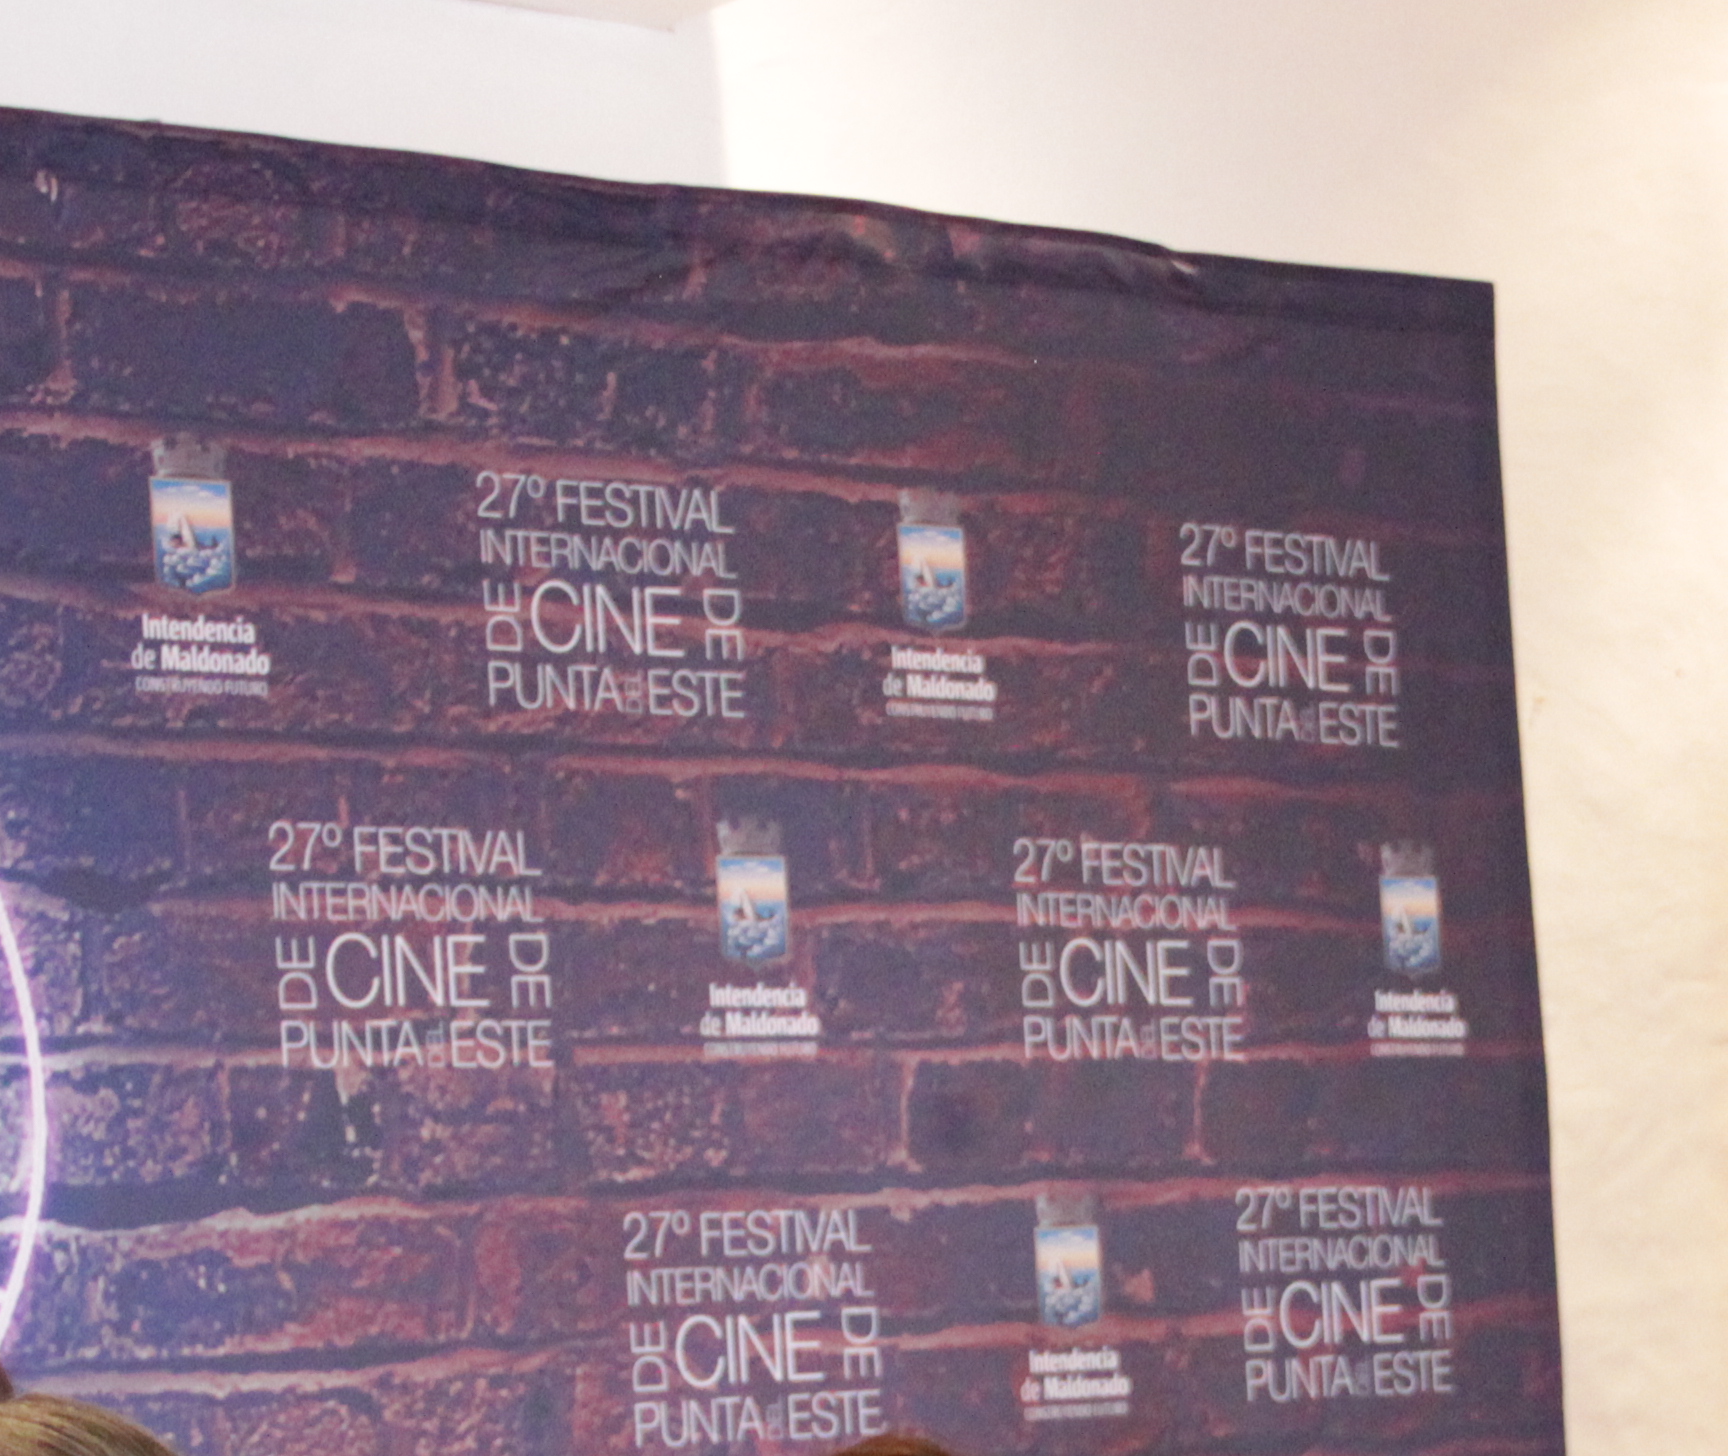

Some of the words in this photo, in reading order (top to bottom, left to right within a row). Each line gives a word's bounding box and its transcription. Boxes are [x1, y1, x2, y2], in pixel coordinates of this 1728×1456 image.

[556, 479, 735, 534] FESTIVAL
[480, 528, 738, 579] INTERNACIONAL
[1245, 528, 1390, 581] FESTIVAL
[483, 579, 522, 652] DE
[531, 579, 685, 657] CINE
[703, 588, 745, 661] DE
[1182, 574, 1393, 622] INTERNACIONAL
[142, 612, 255, 644] Intendencia
[131, 642, 156, 669] de
[160, 644, 271, 675] Maldonado
[891, 645, 985, 674] Intendencia
[1185, 621, 1219, 686] DE
[1224, 620, 1352, 693] CINE
[1363, 630, 1399, 695] DE
[488, 660, 624, 712] PUNTA
[647, 668, 746, 718] ESTE
[883, 672, 903, 696] de
[906, 673, 997, 702] Maldonado
[1189, 693, 1302, 740] PUNTA
[1319, 701, 1399, 748] ESTE
[353, 825, 543, 876] FESTIVAL
[1081, 841, 1237, 888] FESTIVAL
[271, 881, 545, 923] INTERNACIONAL
[1016, 892, 1237, 931] INTERNACIONAL
[275, 935, 318, 1010] DE
[326, 932, 491, 1009] CINE
[508, 933, 552, 1008] DE
[709, 981, 806, 1008] Intendencia
[1019, 941, 1055, 1008] DE
[1059, 937, 1194, 1007] CINE
[1207, 939, 1244, 1006] DE
[280, 1019, 424, 1069] PUNTA
[450, 1019, 554, 1069] ESTE
[700, 1011, 721, 1036] de
[725, 1011, 821, 1036] Maldonado
[1023, 1015, 1141, 1061] PUNTA
[1160, 1016, 1245, 1061] ESTE
[1299, 1185, 1444, 1229] FESTIVAL
[700, 1209, 874, 1257] FESTIVAL
[1238, 1233, 1445, 1273] INTERNACIONAL
[627, 1261, 875, 1306] INTERNACIONAL
[1241, 1286, 1275, 1352] DE
[1279, 1277, 1405, 1349] CINE
[1417, 1274, 1452, 1341] DE
[630, 1321, 669, 1393] DE
[675, 1310, 825, 1388] CINE
[841, 1306, 883, 1380] DE
[1029, 1345, 1120, 1373] Intendencia
[1044, 1373, 1131, 1400] Maldonado
[1245, 1354, 1357, 1403] PUNTA
[1373, 1349, 1453, 1397] ESTE
[634, 1396, 767, 1448] PUNTA
[788, 1389, 887, 1440] ESTE
